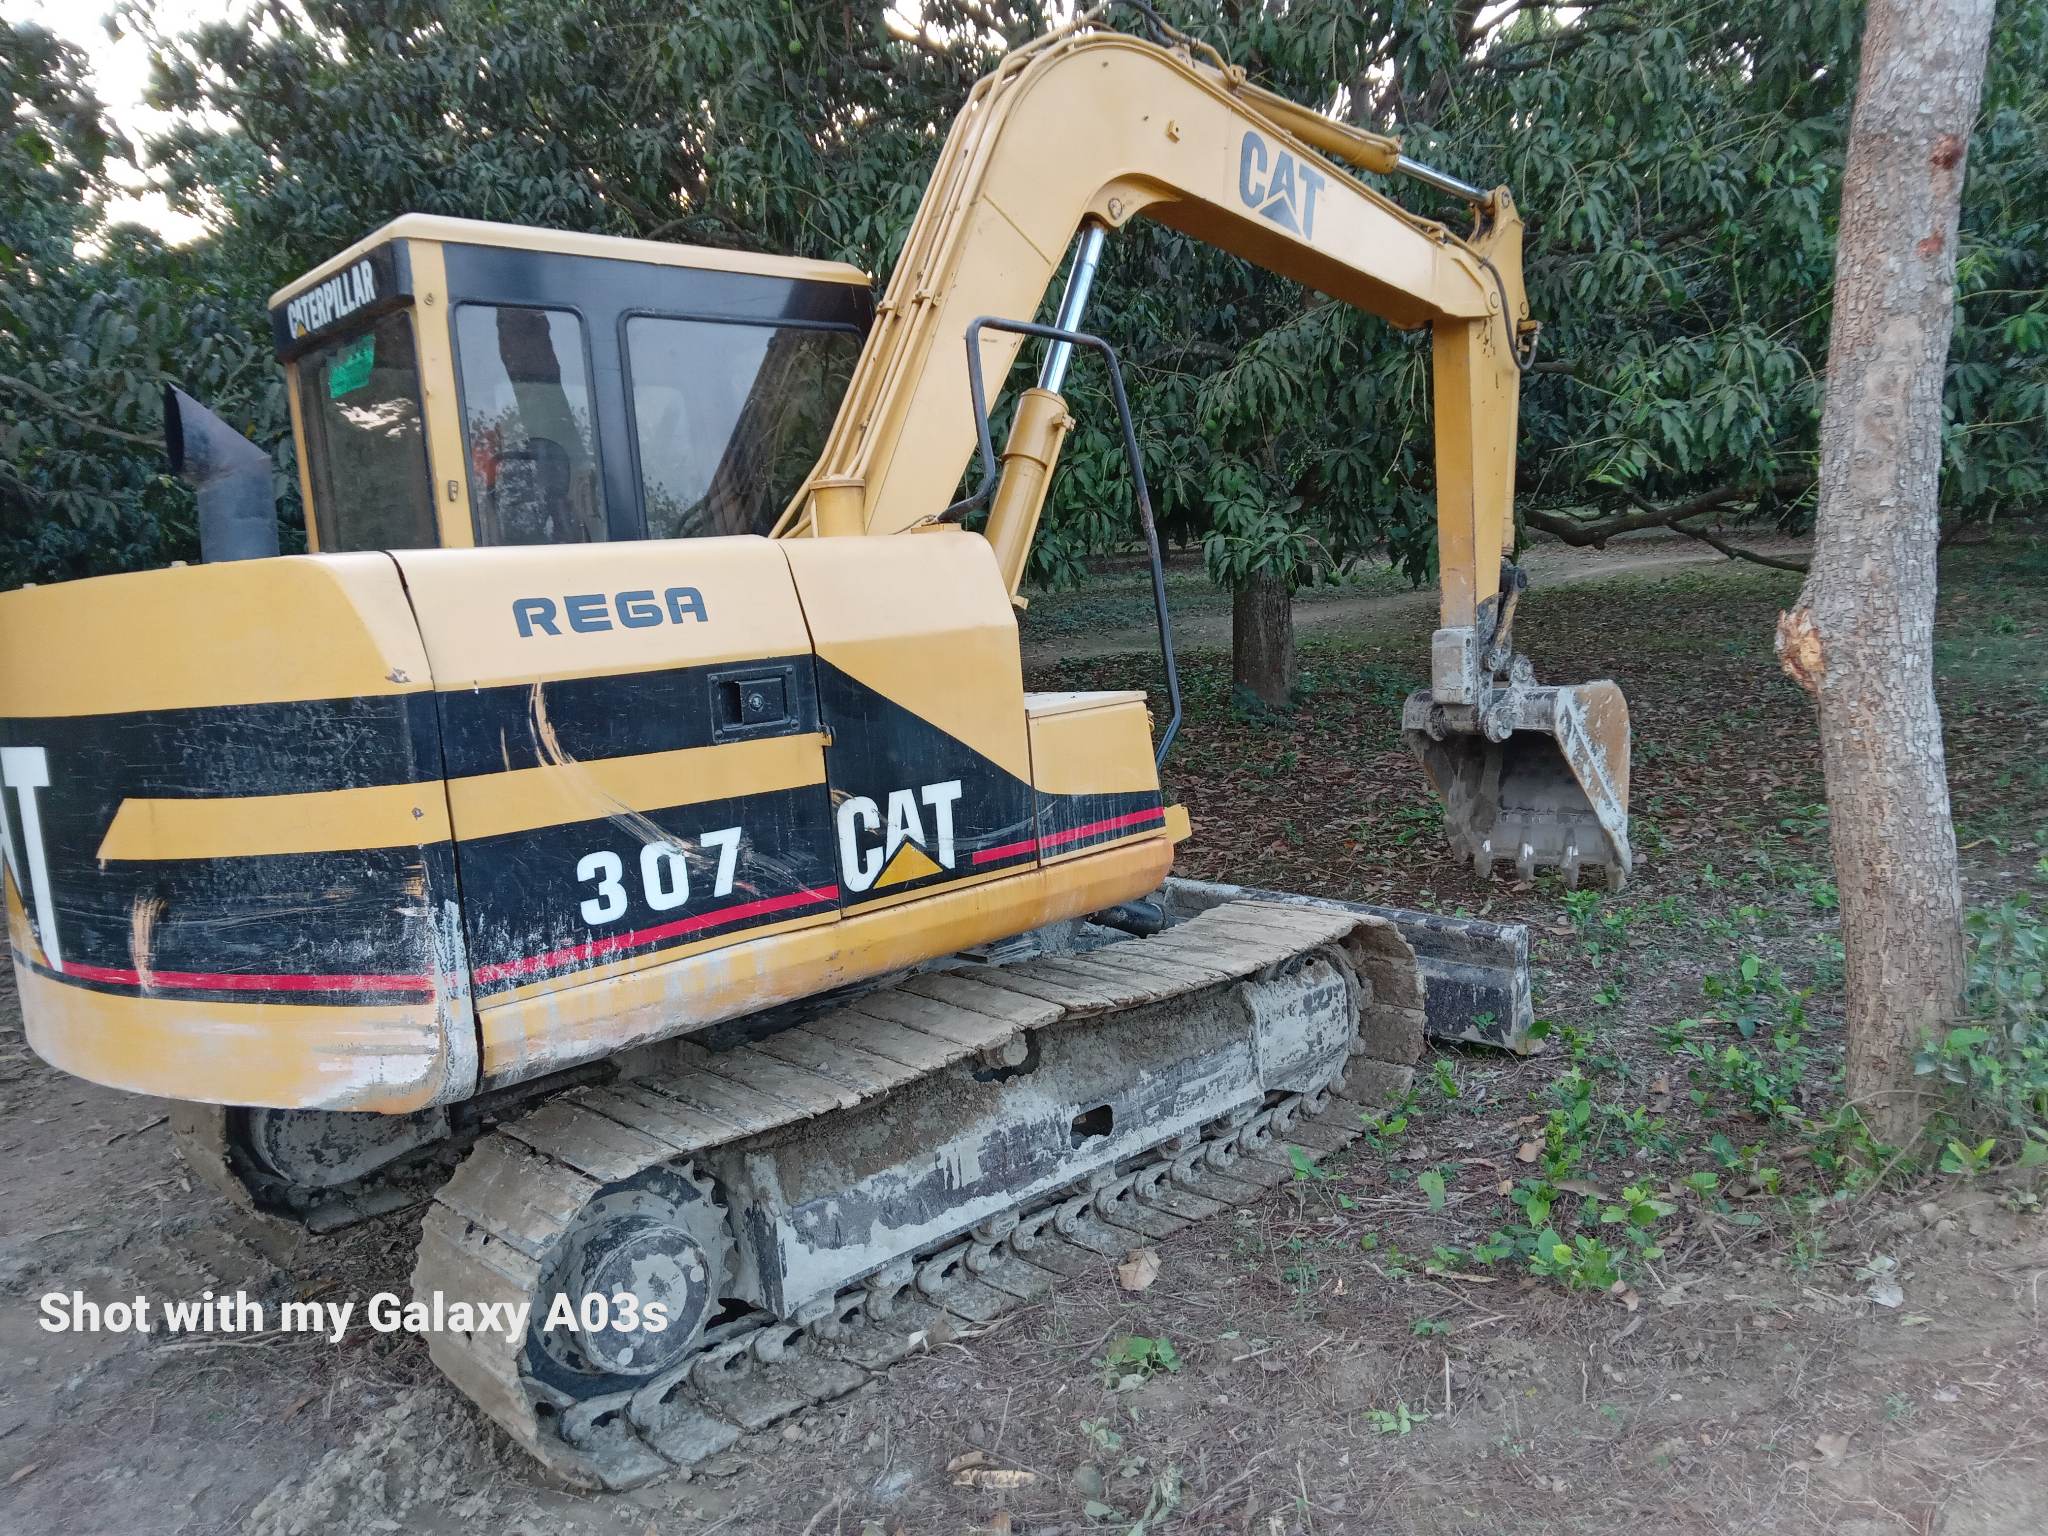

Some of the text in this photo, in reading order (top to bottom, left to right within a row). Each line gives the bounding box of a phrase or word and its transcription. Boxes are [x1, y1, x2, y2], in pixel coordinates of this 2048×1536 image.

[1239, 131, 1325, 241] CAT
[287, 260, 376, 339] CATERPILLAR
[512, 587, 709, 637] REGA
[576, 826, 742, 926] 307
[836, 780, 963, 893] CAT
